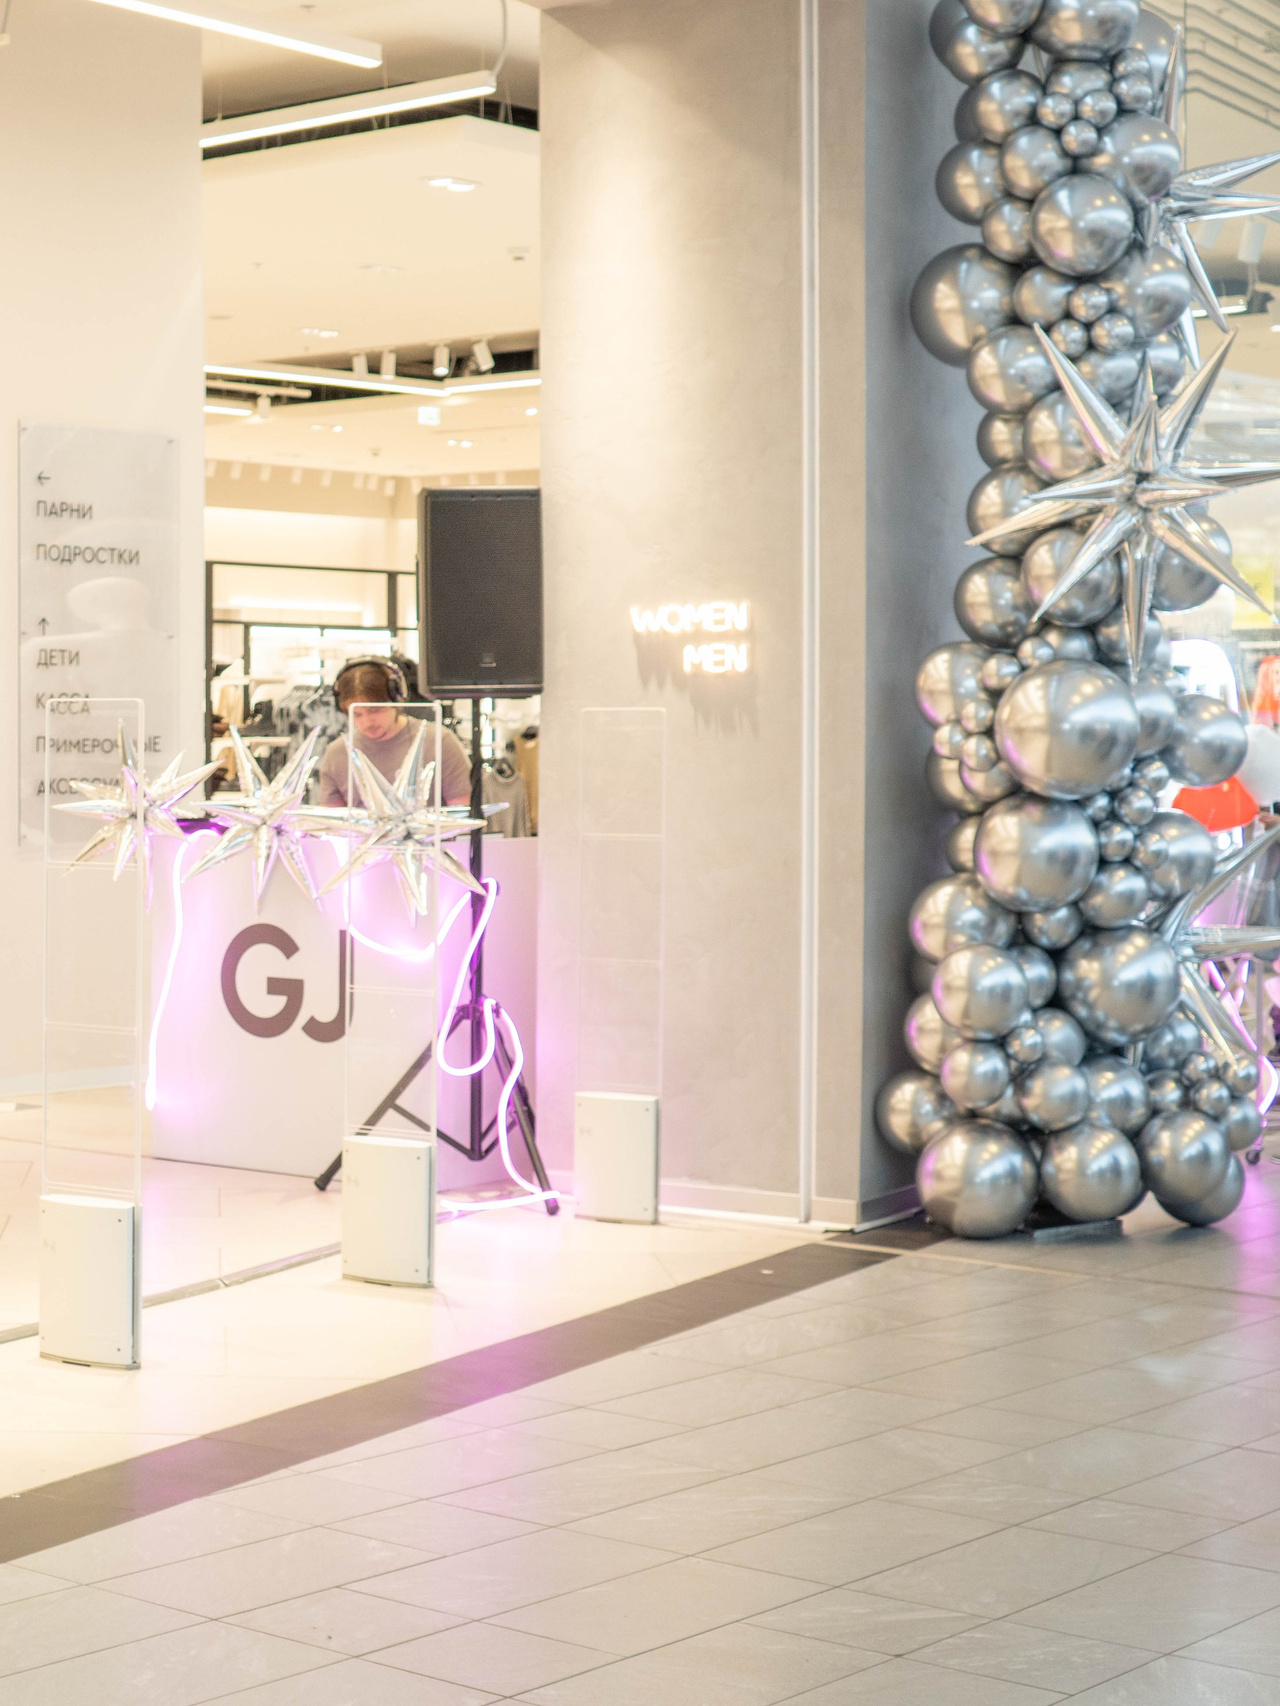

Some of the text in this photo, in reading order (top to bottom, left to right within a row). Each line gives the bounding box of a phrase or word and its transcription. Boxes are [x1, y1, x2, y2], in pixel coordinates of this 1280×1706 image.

[35, 499, 94, 520] ПАРНИ
[35, 542, 141, 566] ПОДРОСТКИ
[629, 601, 749, 633] WOMEN
[35, 647, 81, 668] ДЕТИ
[682, 642, 749, 673] MEN
[35, 691, 91, 716] КАССА
[35, 734, 163, 755] ПРИМЕРОЫЕ
[220, 923, 355, 1043] GJ
